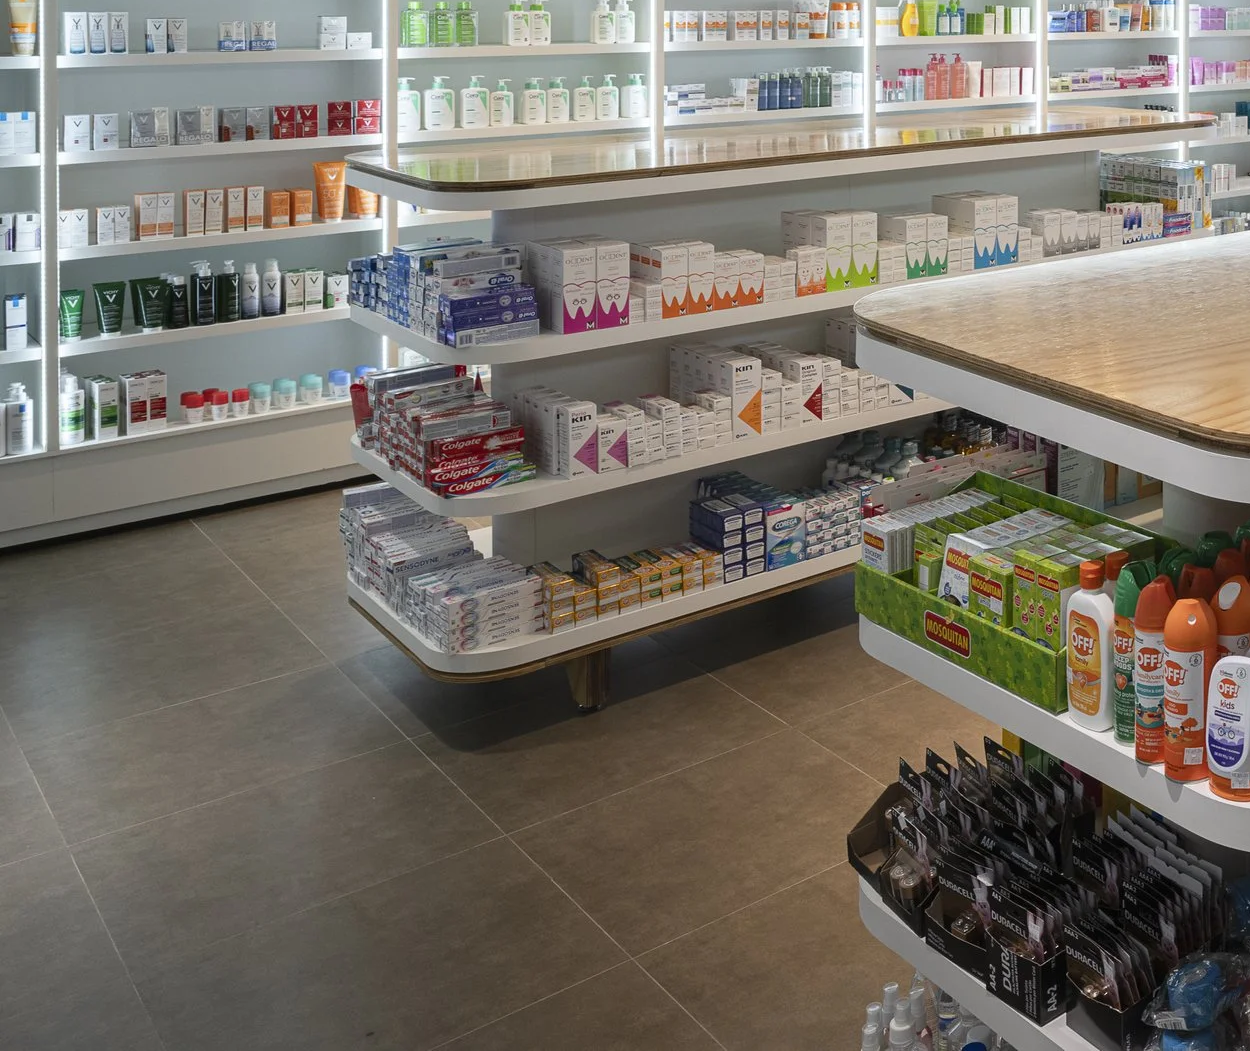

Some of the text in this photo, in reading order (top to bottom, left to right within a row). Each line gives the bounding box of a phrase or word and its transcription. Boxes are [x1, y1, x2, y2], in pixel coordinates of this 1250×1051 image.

[442, 437, 482, 451] Colgate
[435, 465, 480, 482] Colgate
[448, 476, 493, 493] Colgate
[774, 518, 799, 530] COREGA
[395, 556, 440, 574] SENSODYNE
[971, 573, 1002, 599] MOSQUITAN
[927, 619, 969, 651] MOSQUITAN
[1071, 631, 1095, 654] OFF!
[1137, 651, 1164, 668] OFF!
[1164, 665, 1187, 686] OFF!
[1218, 682, 1240, 697] OFF!
[1220, 699, 1235, 711] kids
[1073, 855, 1105, 884] DURACELL
[938, 875, 976, 901] DURACELL
[991, 910, 1028, 940] DURACELL
[1124, 909, 1161, 941] DURACELL
[1065, 945, 1102, 975] DURACELL
[989, 964, 997, 991] AA-2
[1046, 984, 1058, 1013] AA-2
